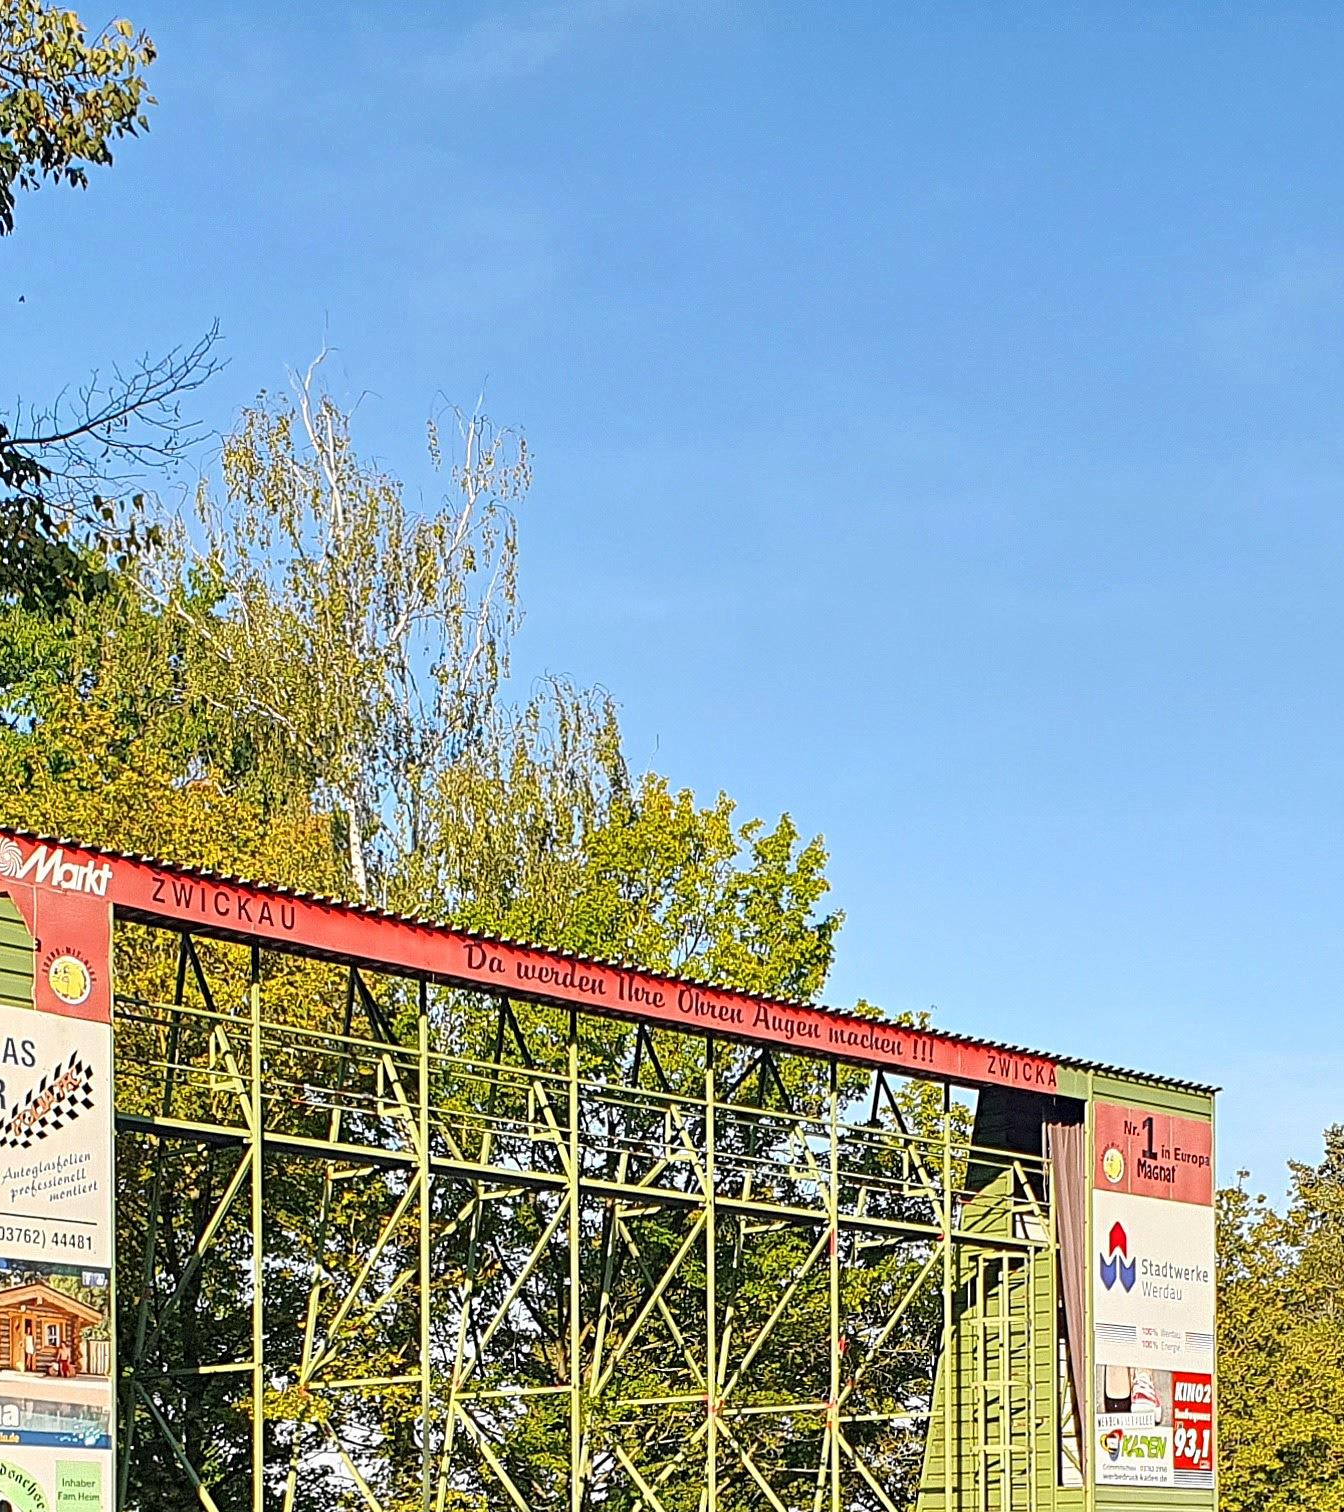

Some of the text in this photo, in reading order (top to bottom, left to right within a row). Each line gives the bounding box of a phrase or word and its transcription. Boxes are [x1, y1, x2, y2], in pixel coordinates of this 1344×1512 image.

[15, 845, 113, 897] Markt
[151, 876, 296, 930] ZWICKAU
[463, 942, 935, 1063] Da werden Ihre Ohren Augen machen !!!
[1123, 1120, 1140, 1137] Nr.
[1142, 1116, 1158, 1161] 1
[1161, 1144, 1171, 1160] in
[1174, 1148, 1210, 1167] Europa
[1, 1153, 91, 1185] Autoglasfolien
[1137, 1158, 1176, 1183] Magnat
[10, 1168, 86, 1203] professionell
[49, 1181, 98, 1202] montiert
[51, 1232, 93, 1251] 44481
[1141, 1259, 1209, 1283] Stadtwerke
[1142, 1282, 1183, 1301] Werdau
[1174, 1427, 1211, 1465] 93,1
[62, 1478, 96, 1488] Inhaber
